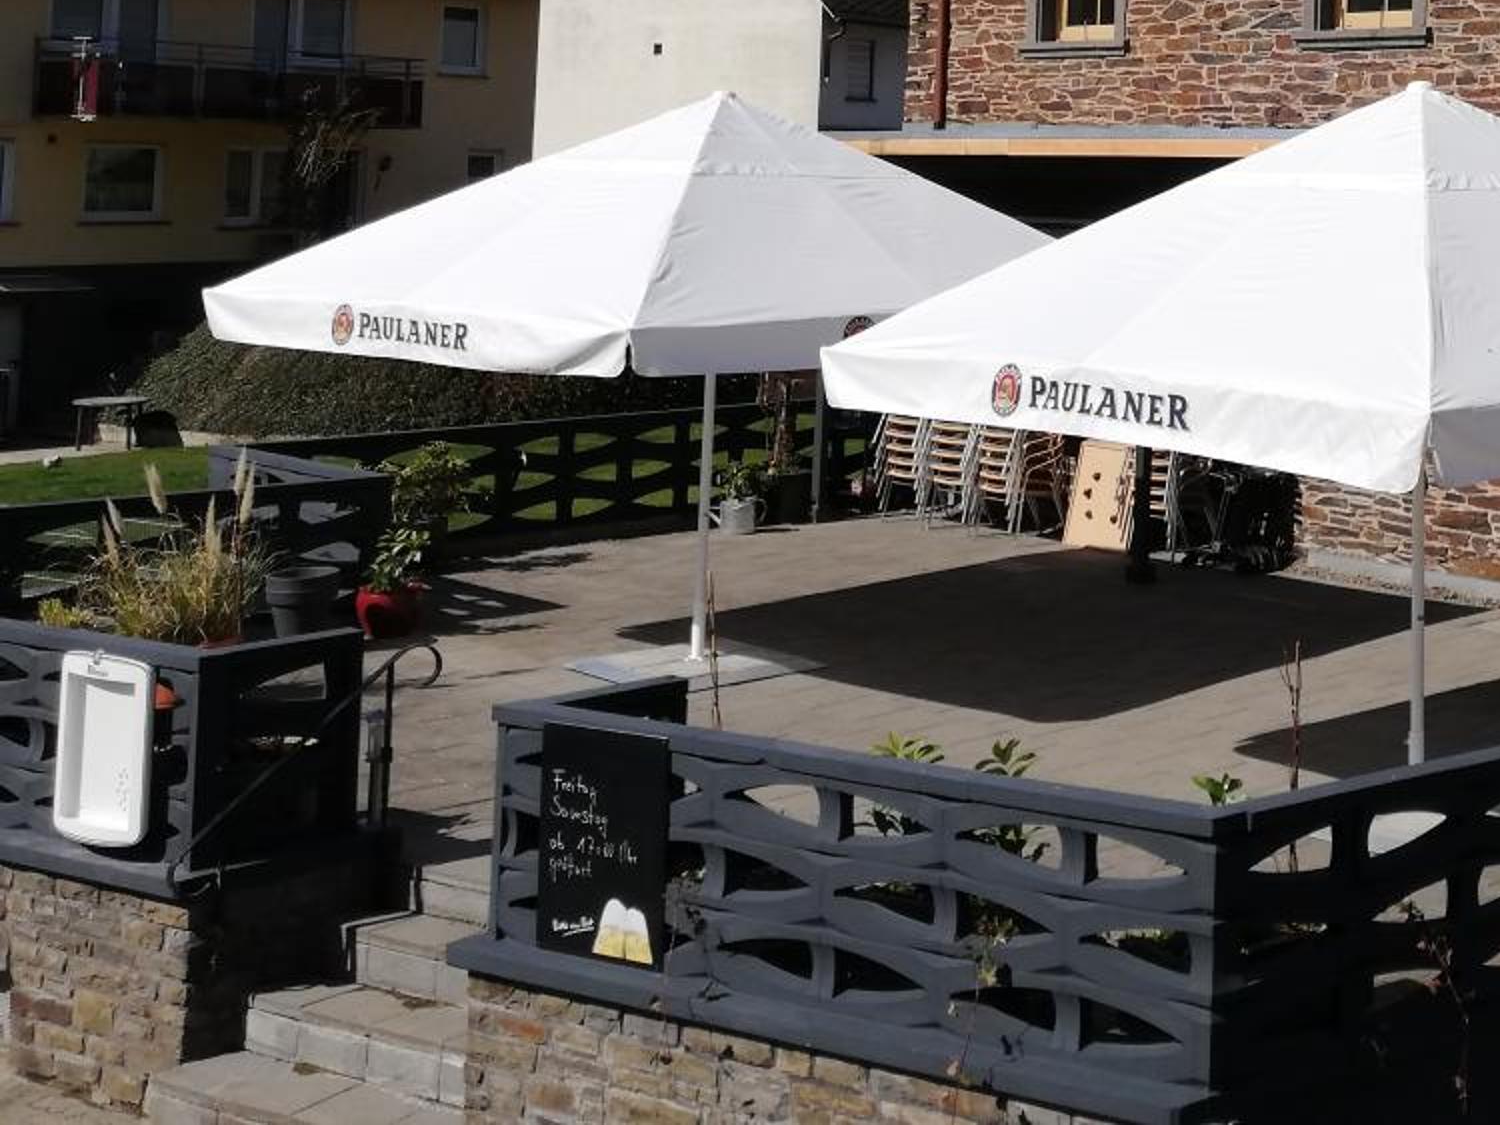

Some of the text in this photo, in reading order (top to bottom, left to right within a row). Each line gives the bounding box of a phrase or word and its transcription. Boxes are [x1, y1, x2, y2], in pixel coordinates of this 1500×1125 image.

[357, 312, 468, 351] PAULANER
[1029, 376, 1191, 431] PAULANER
[551, 768, 598, 806] Freitag
[549, 830, 566, 851] ab
